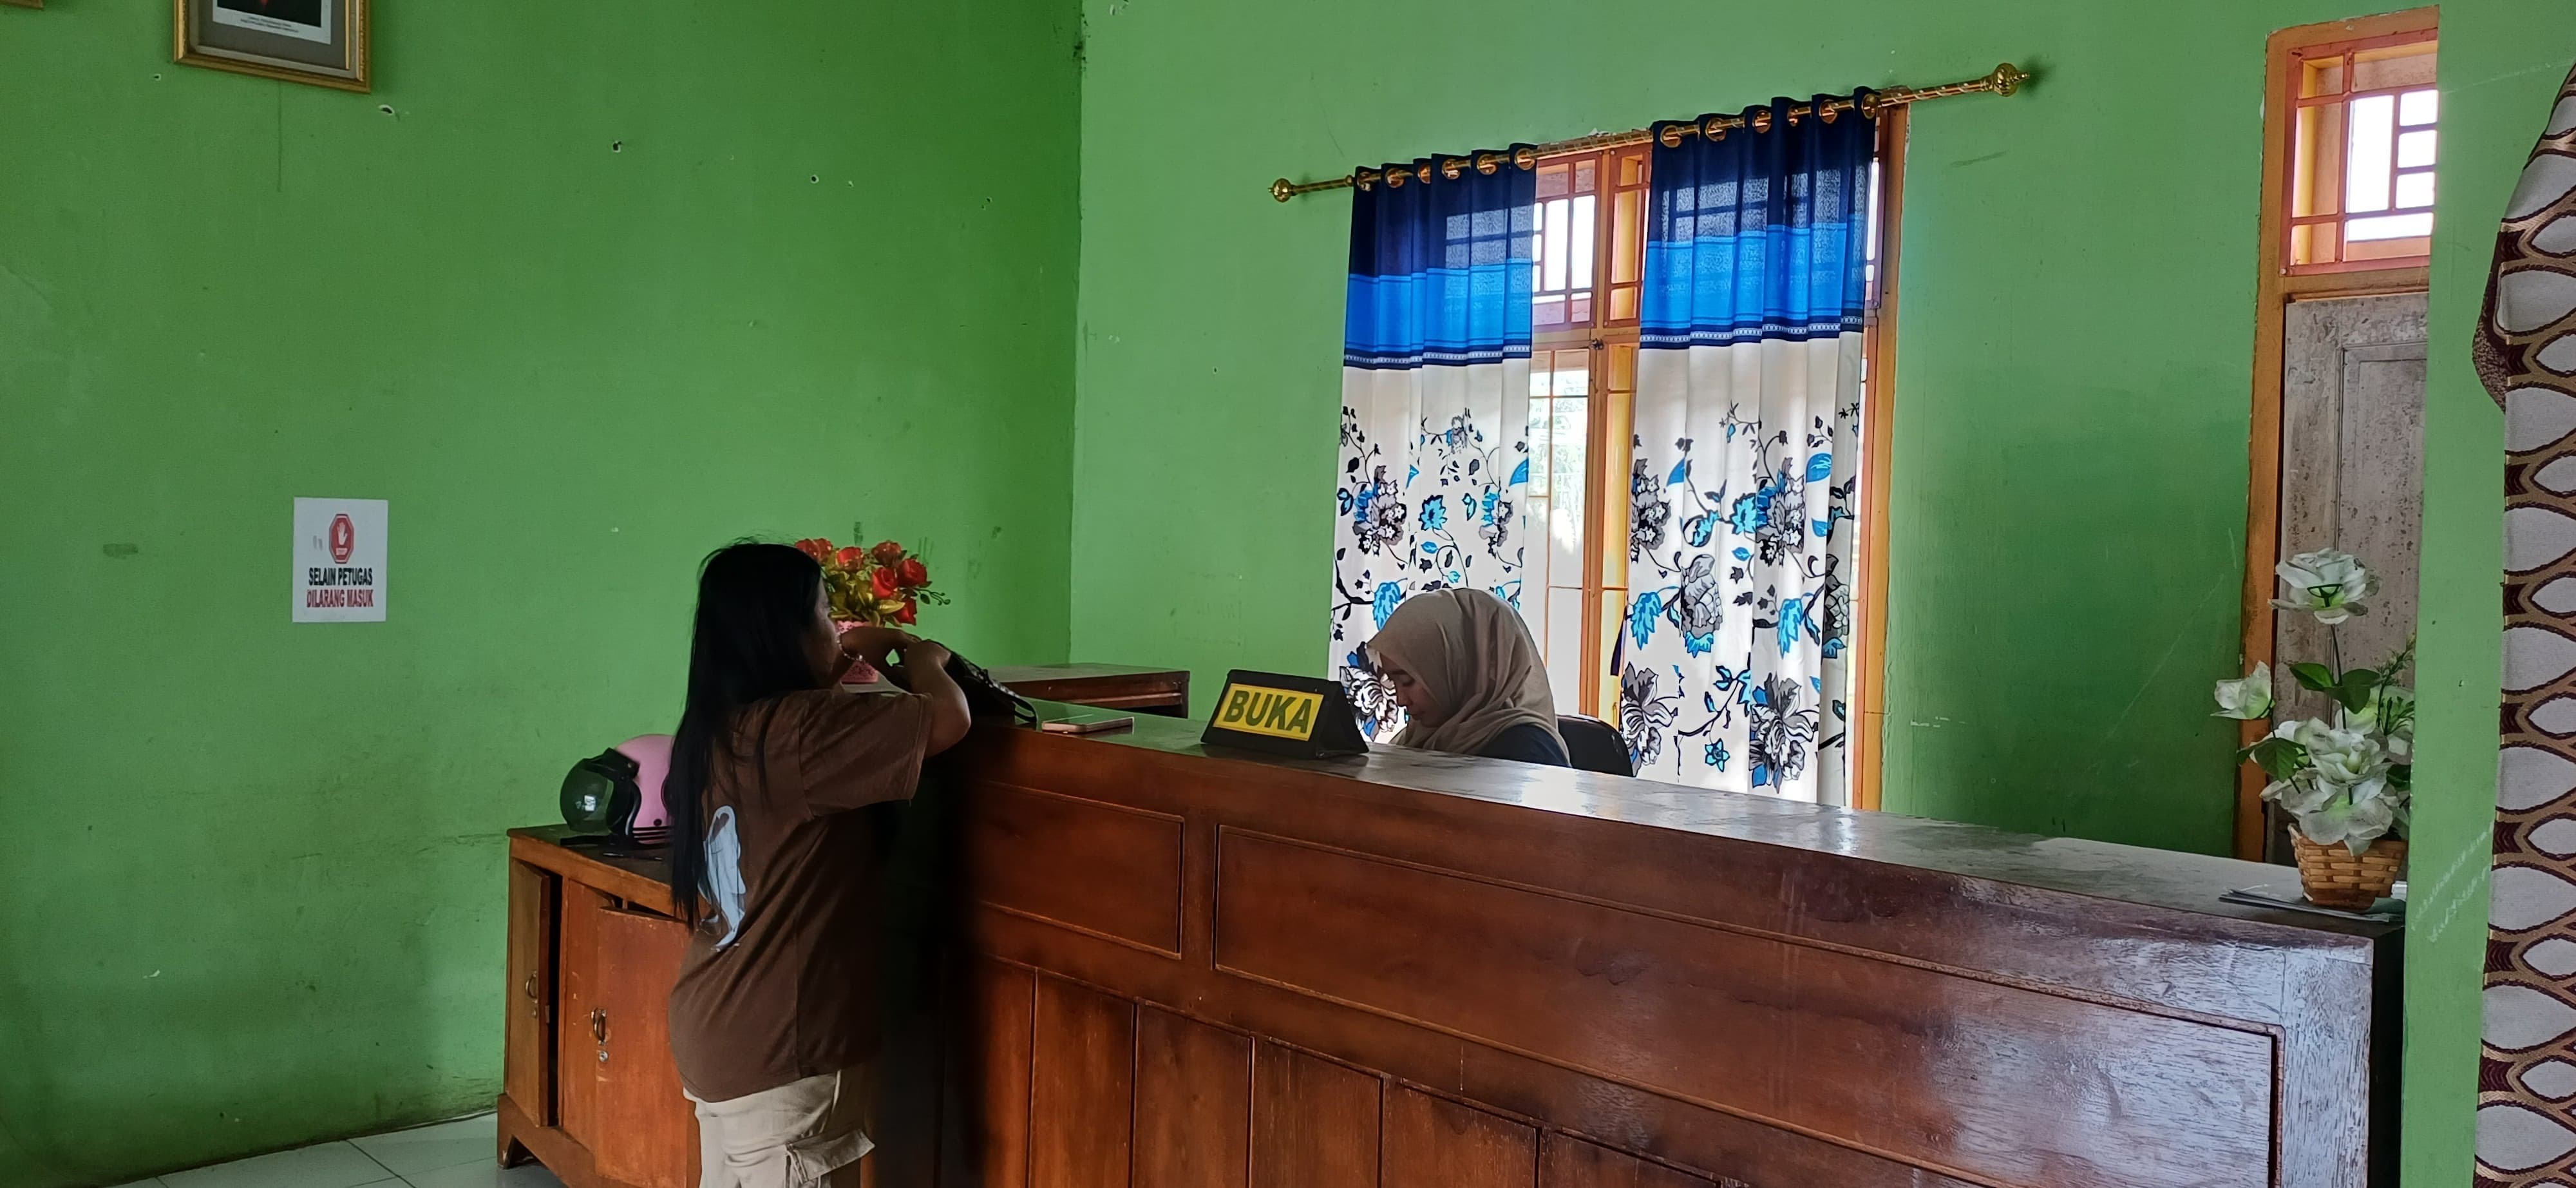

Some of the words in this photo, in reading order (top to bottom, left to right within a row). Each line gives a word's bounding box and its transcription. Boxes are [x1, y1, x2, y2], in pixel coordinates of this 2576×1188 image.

[309, 568, 336, 586] SELAIN
[338, 568, 373, 586] PETUGAS
[307, 589, 345, 608] DILARANG
[347, 589, 374, 607] MASUK
[1223, 690, 1312, 734] BUKA
